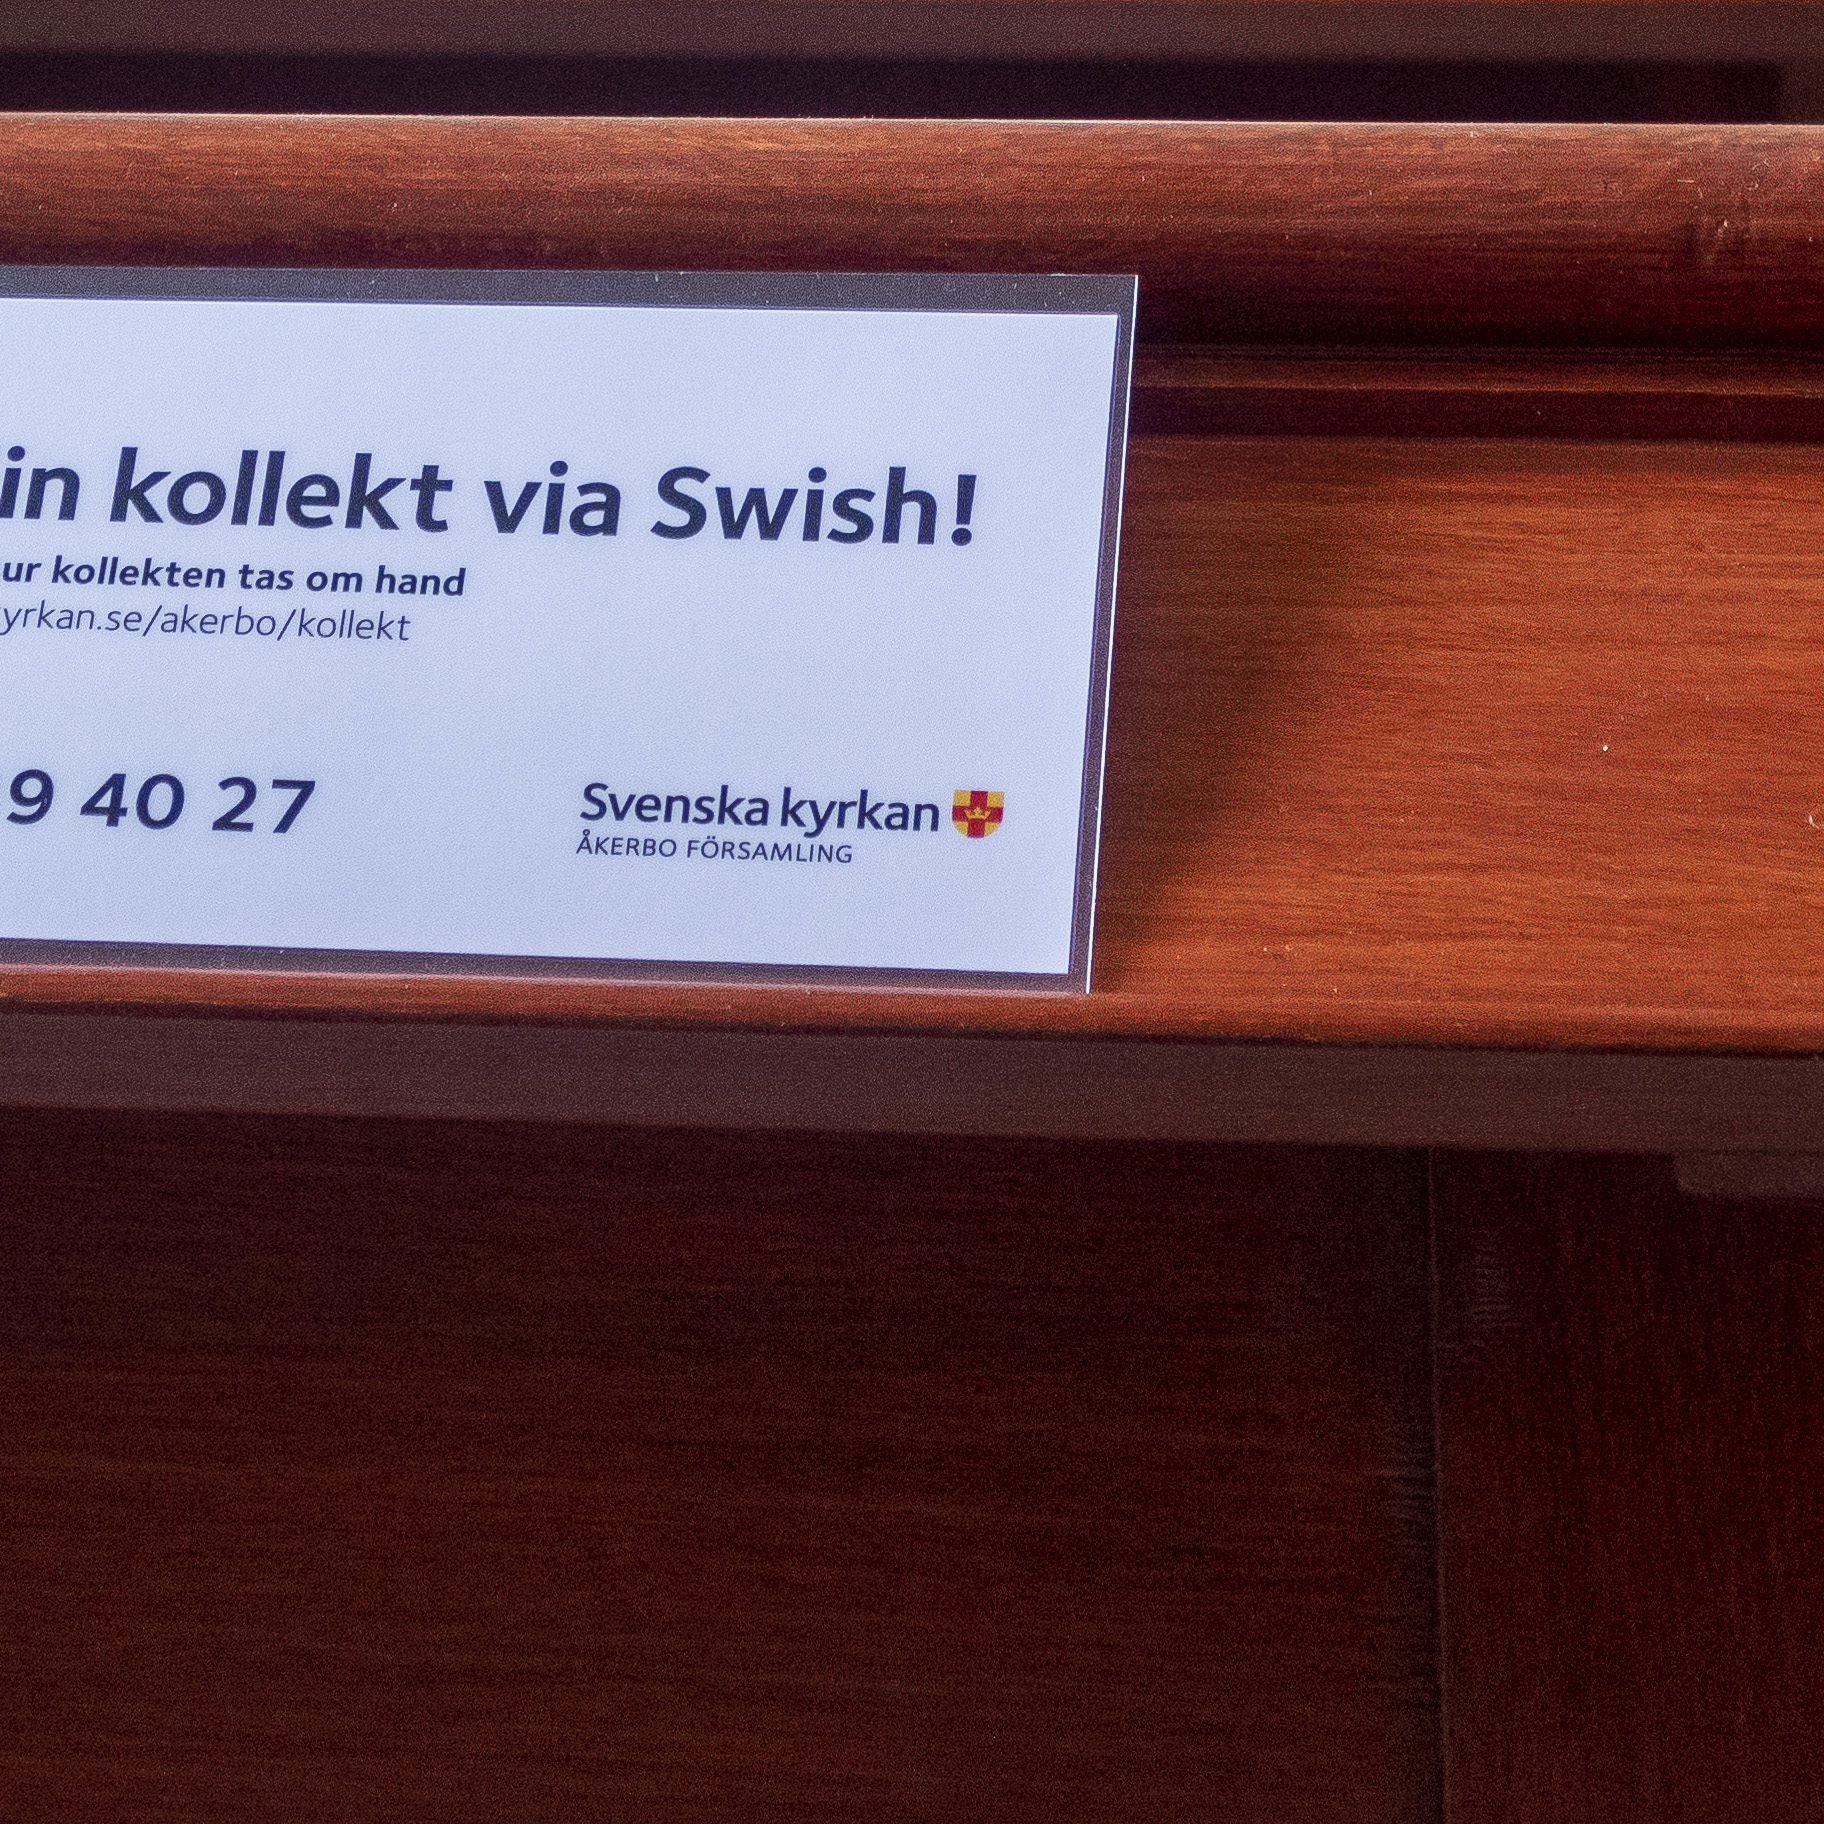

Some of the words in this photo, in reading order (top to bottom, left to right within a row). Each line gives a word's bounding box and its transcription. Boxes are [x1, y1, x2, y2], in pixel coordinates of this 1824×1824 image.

[109, 446, 454, 534] kollekt
[483, 459, 622, 537] via
[650, 465, 978, 547] Swish!
[51, 554, 227, 589] kollekten
[238, 563, 295, 591] tas
[305, 570, 364, 593] om
[374, 564, 467, 597] hand
[79, 772, 186, 830] 40
[211, 775, 316, 834] 27
[579, 781, 770, 827] Svenska
[780, 786, 940, 839] kyrkan
[575, 828, 678, 858] ÅKERBO
[686, 835, 853, 864] FÖRSAMLING
